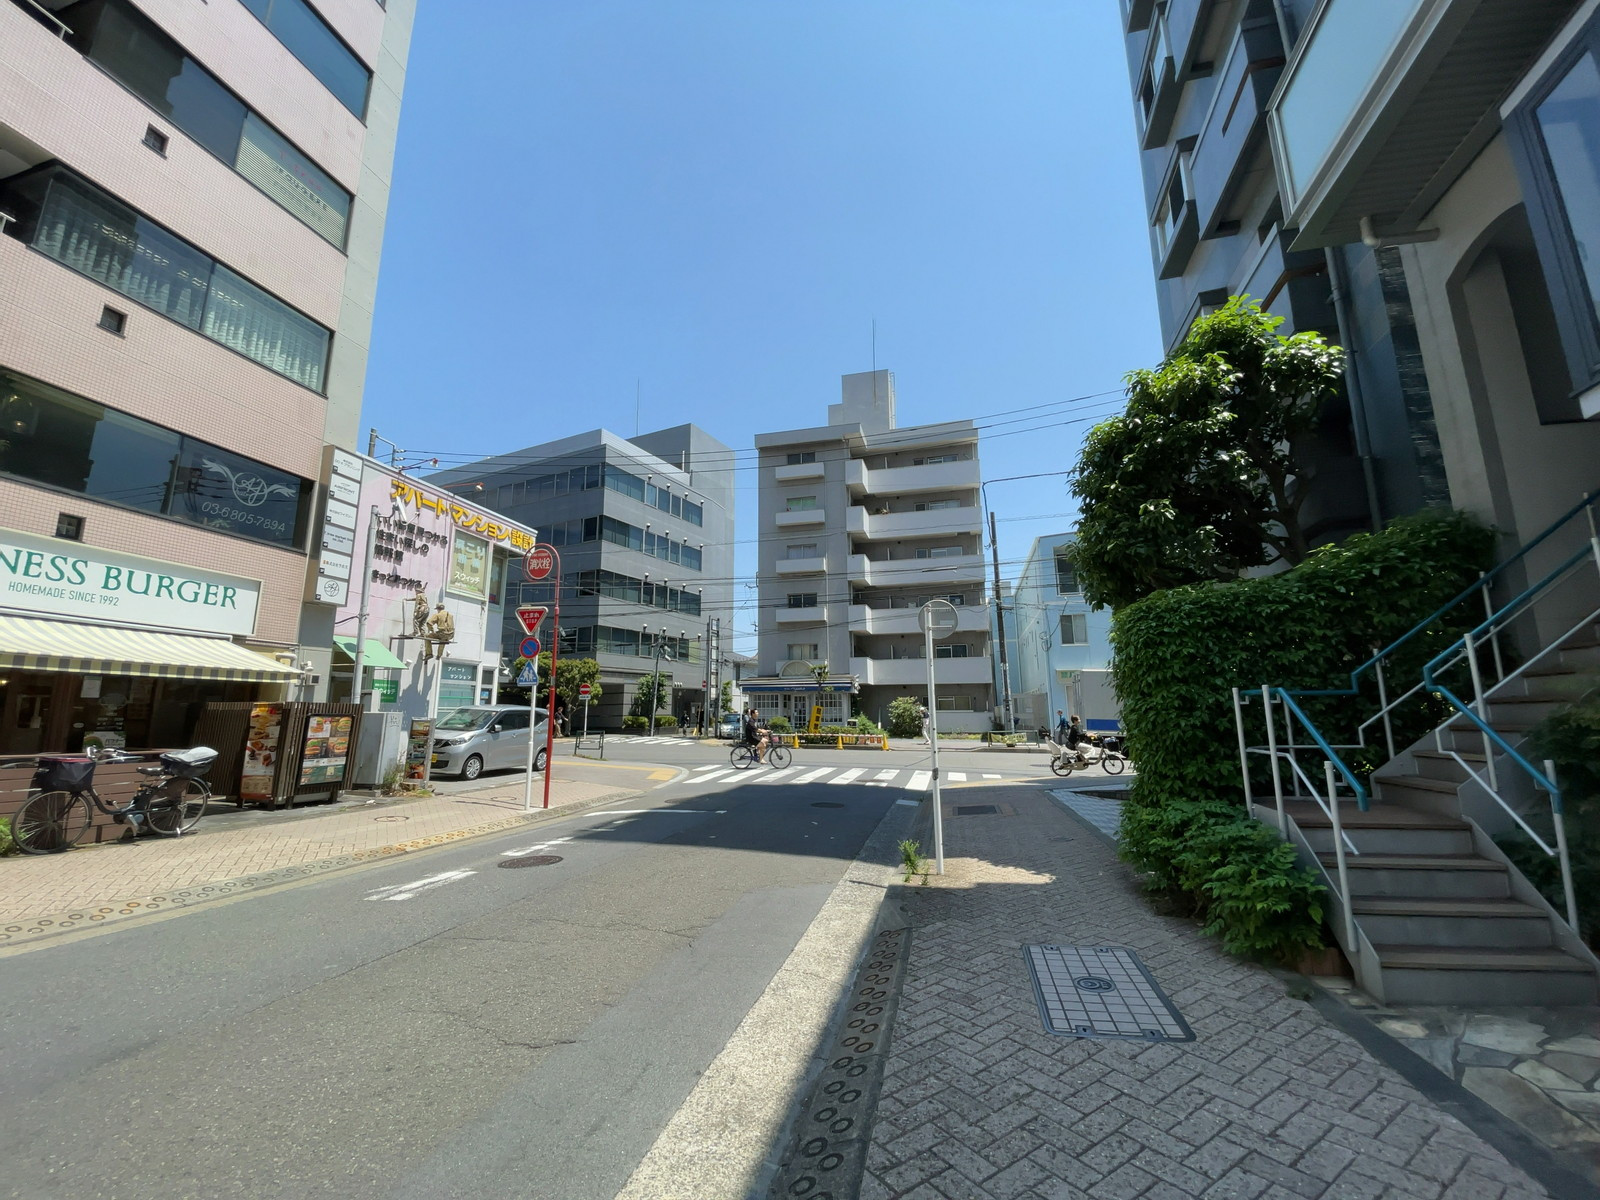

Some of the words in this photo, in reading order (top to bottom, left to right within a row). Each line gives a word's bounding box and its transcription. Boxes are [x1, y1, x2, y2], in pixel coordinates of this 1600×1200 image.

[529, 557, 551, 570] 消火栓
[8, 581, 66, 599] HOMEMADE
[68, 590, 97, 603] SINCE
[99, 594, 120, 607] 1992
[101, 565, 237, 610] BURGER
